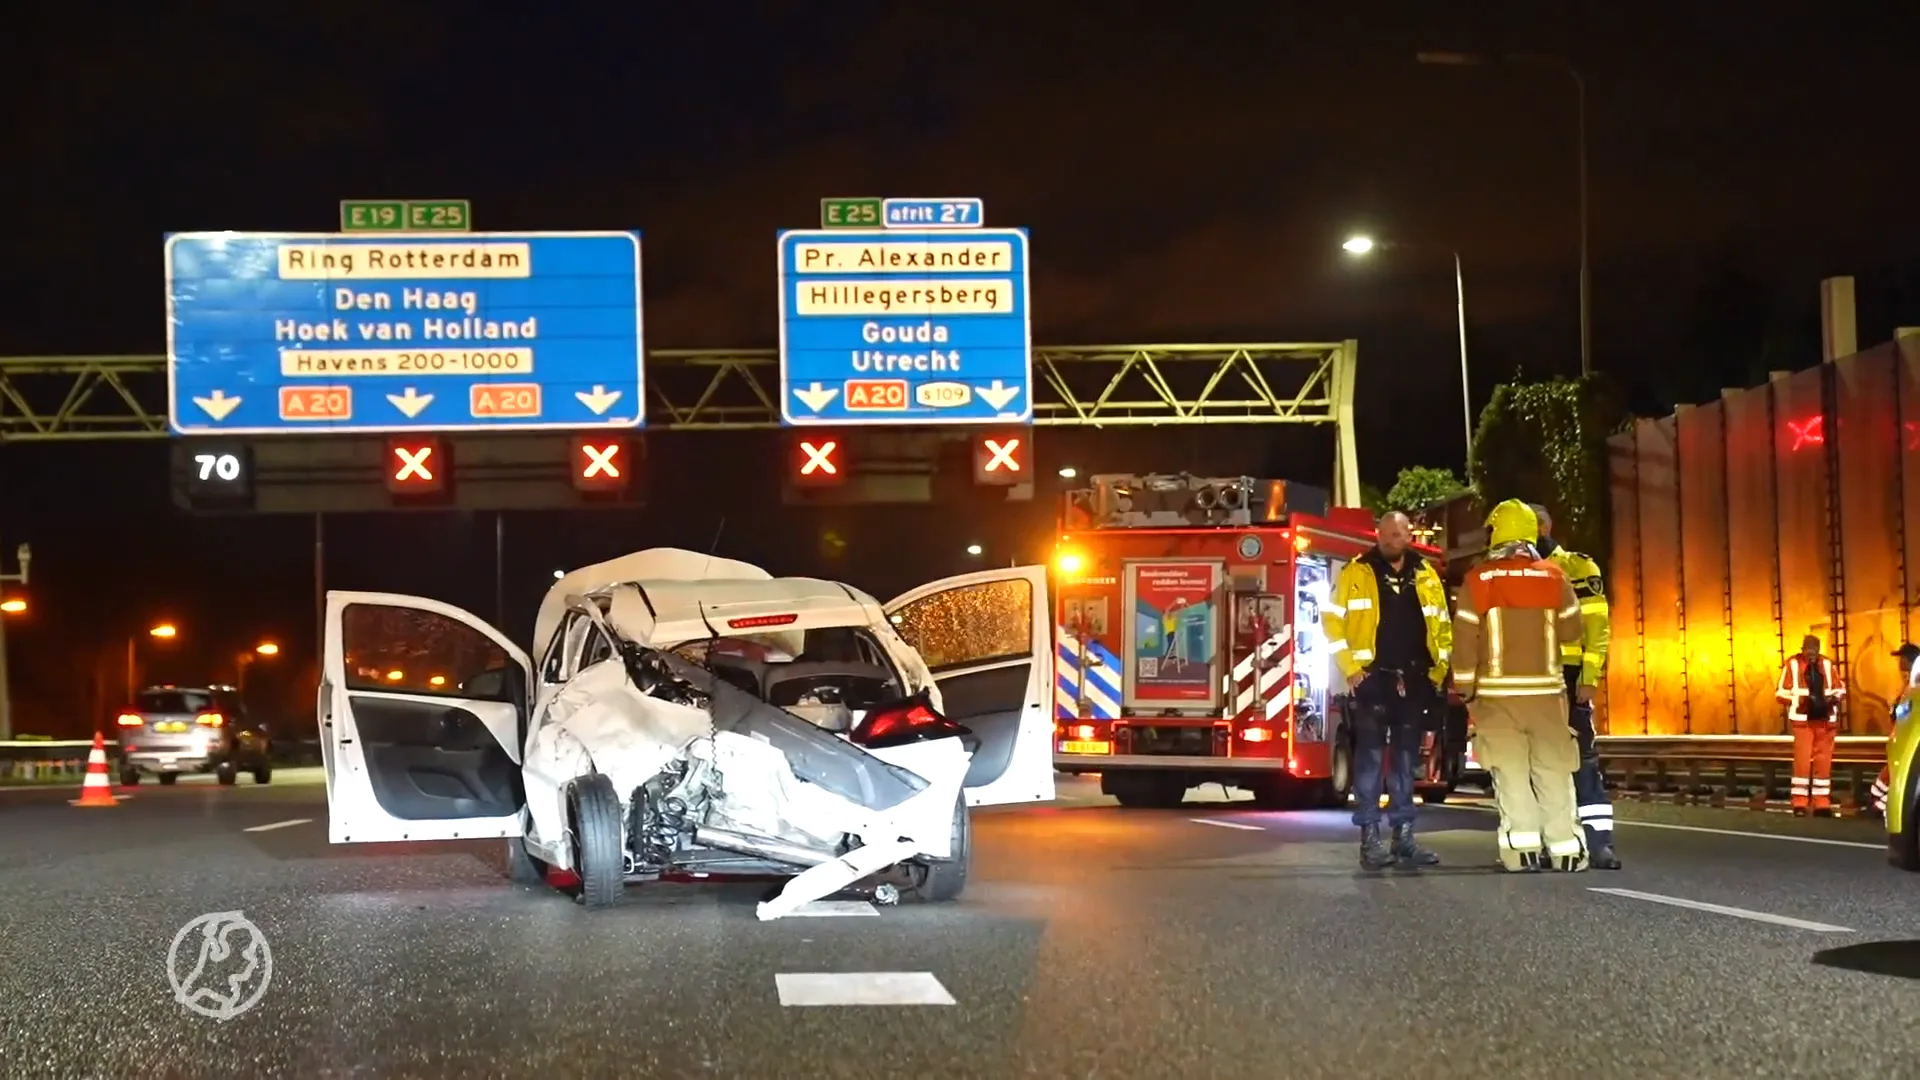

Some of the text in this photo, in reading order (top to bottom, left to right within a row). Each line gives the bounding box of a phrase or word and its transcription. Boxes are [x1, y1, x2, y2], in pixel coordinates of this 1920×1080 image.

[890, 204, 972, 222] afrit 27
[288, 249, 520, 273] Ring Rotterdam
[805, 248, 1001, 267] Pr. Alexander
[335, 288, 477, 314] Den Haag
[811, 286, 998, 309] Hillegersberg
[275, 317, 537, 341] Hoek van Holland
[862, 321, 949, 343] Gouda
[297, 352, 518, 371] Havens 200-1000
[852, 350, 961, 371] Utrecht
[194, 454, 240, 480] 70
